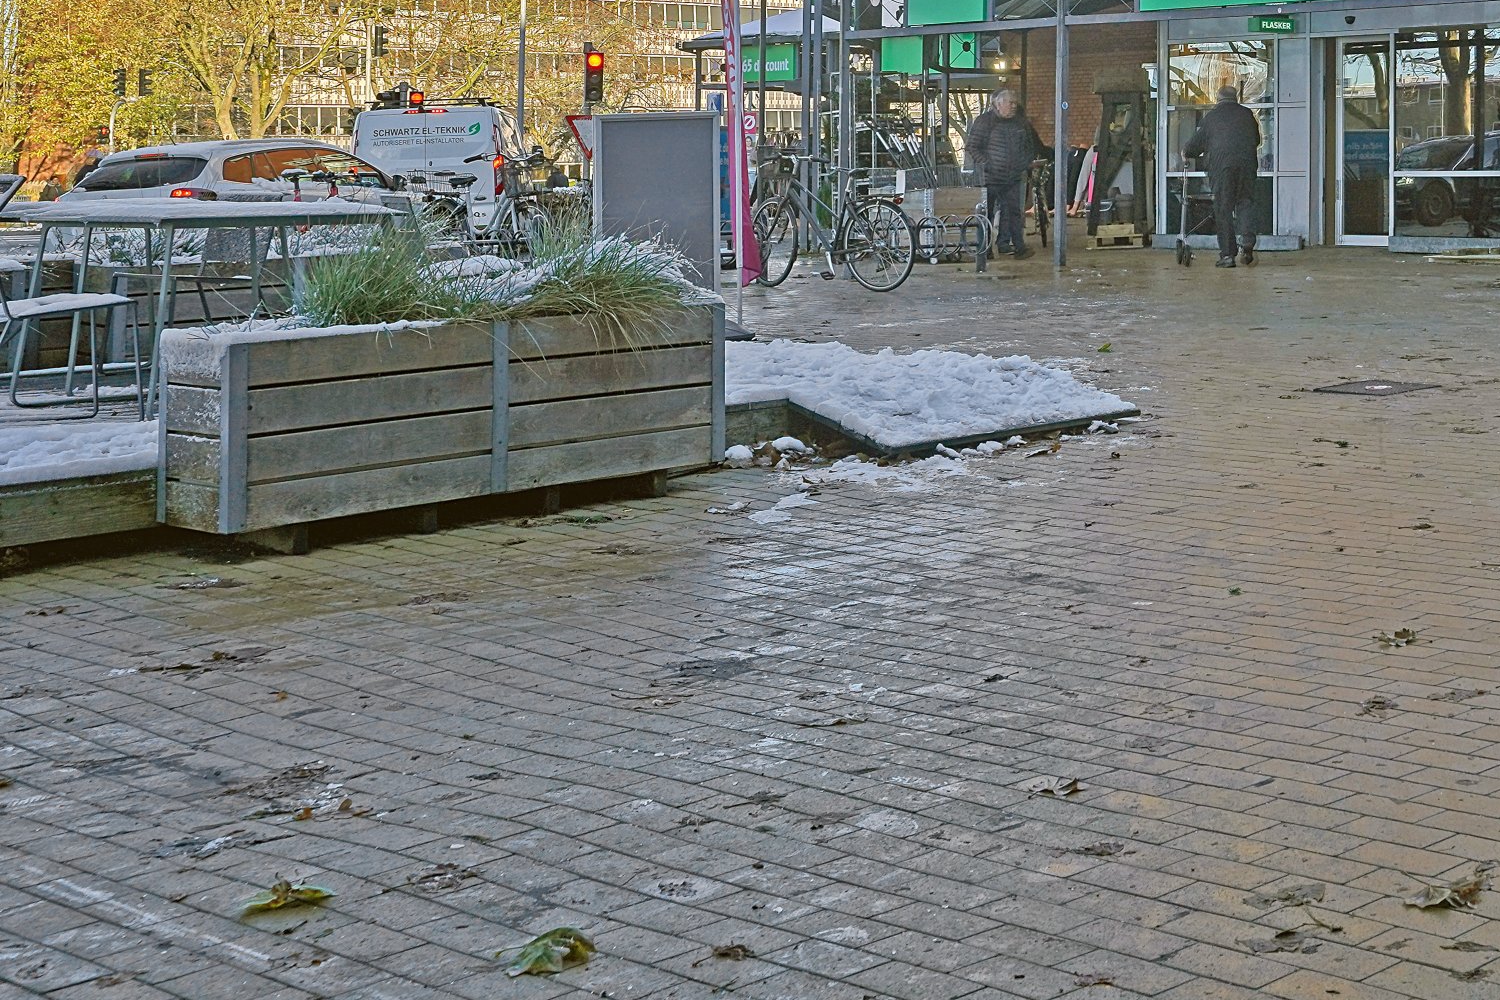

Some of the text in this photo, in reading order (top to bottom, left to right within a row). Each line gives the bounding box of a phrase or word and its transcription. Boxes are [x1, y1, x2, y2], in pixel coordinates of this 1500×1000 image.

[1261, 21, 1291, 30] FLASKER
[742, 58, 789, 72] 65 dcount
[373, 126, 466, 137] SCHWARTZ EL-TEKNIK
[373, 137, 465, 147] AUTORISERET EL-INSTALLATØR
